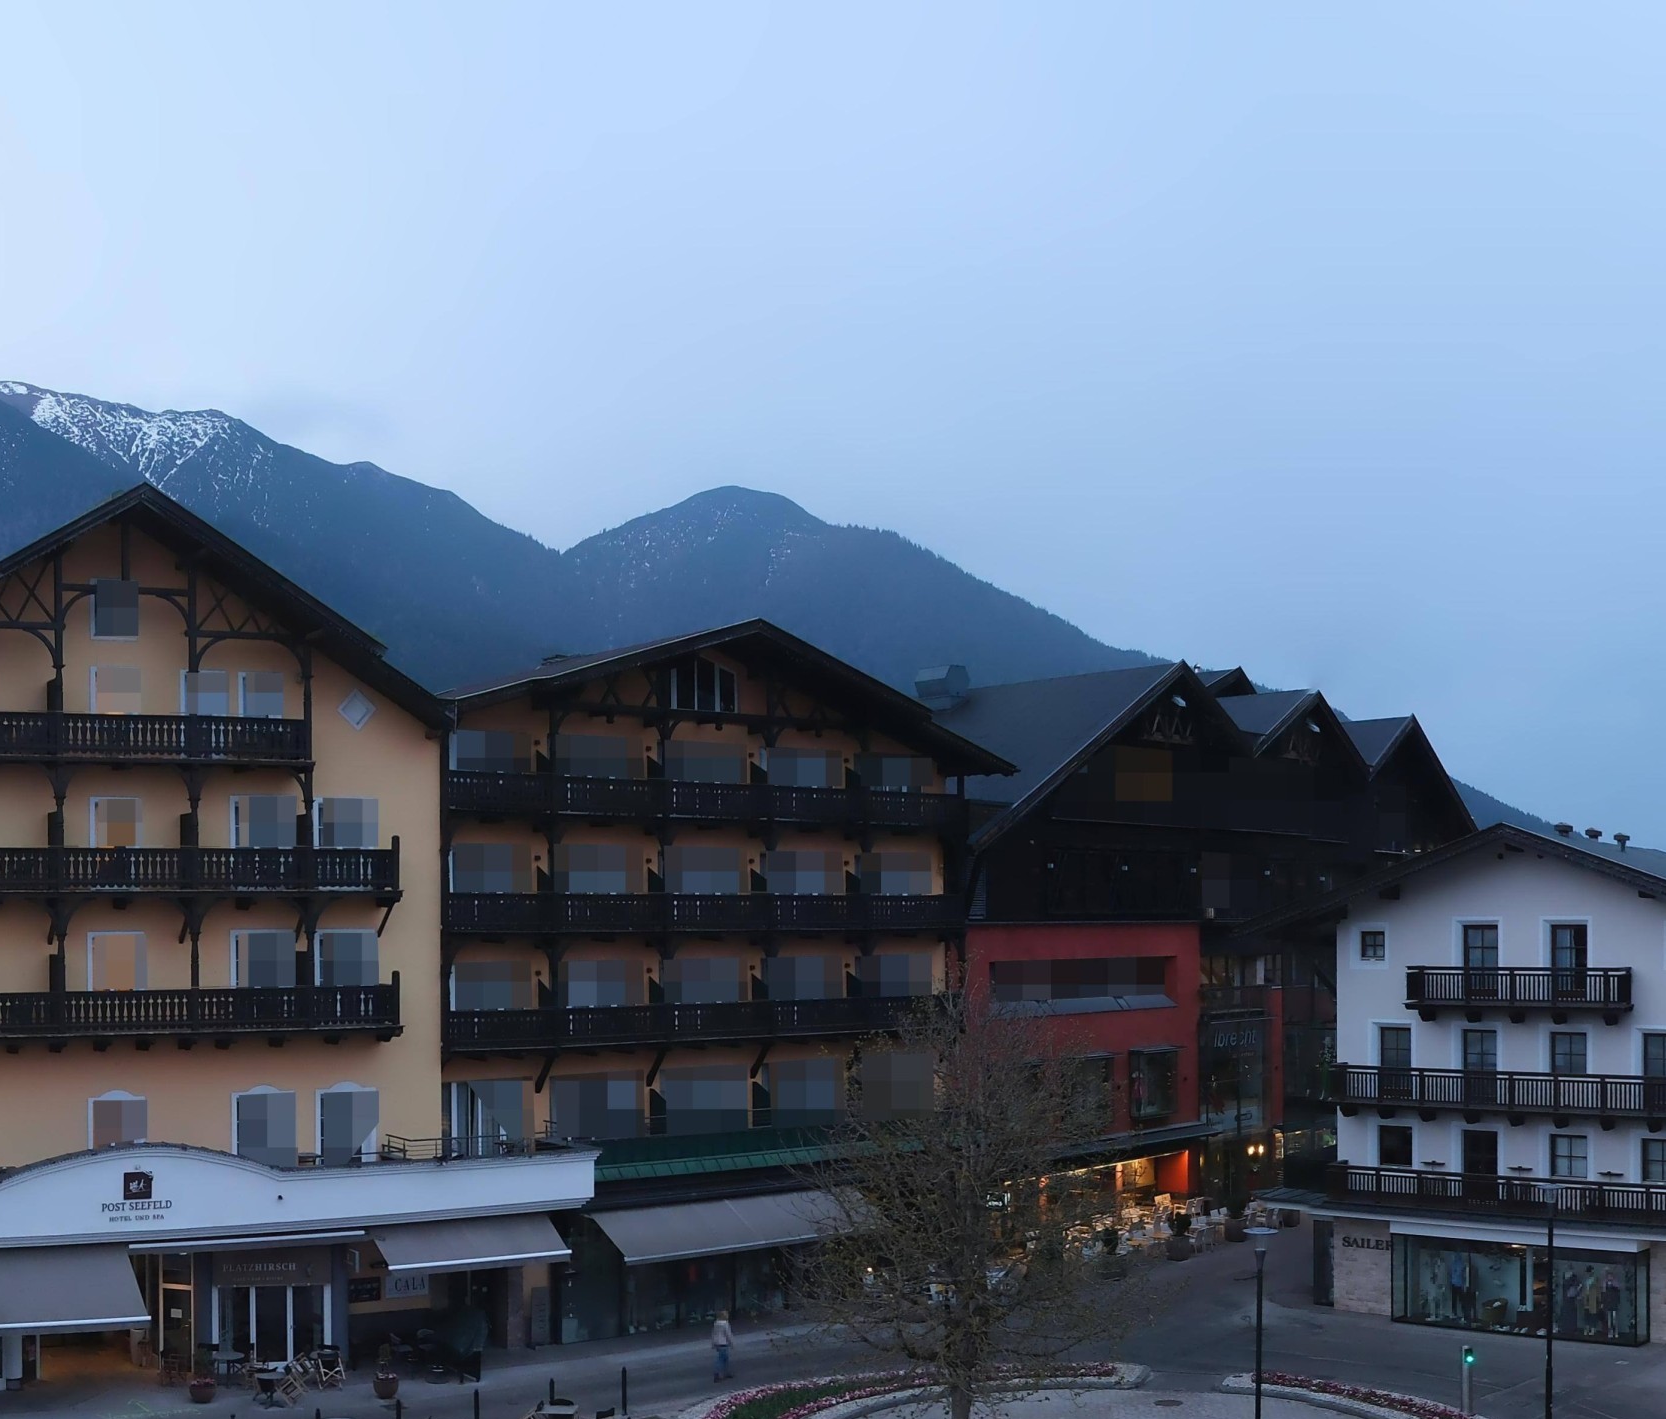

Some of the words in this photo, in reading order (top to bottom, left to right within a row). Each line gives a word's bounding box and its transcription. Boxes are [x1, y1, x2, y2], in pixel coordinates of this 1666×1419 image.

[101, 1202, 127, 1212] POST
[129, 1200, 173, 1211] SEEFELD
[222, 1262, 297, 1273] PLATZHIRSCH
